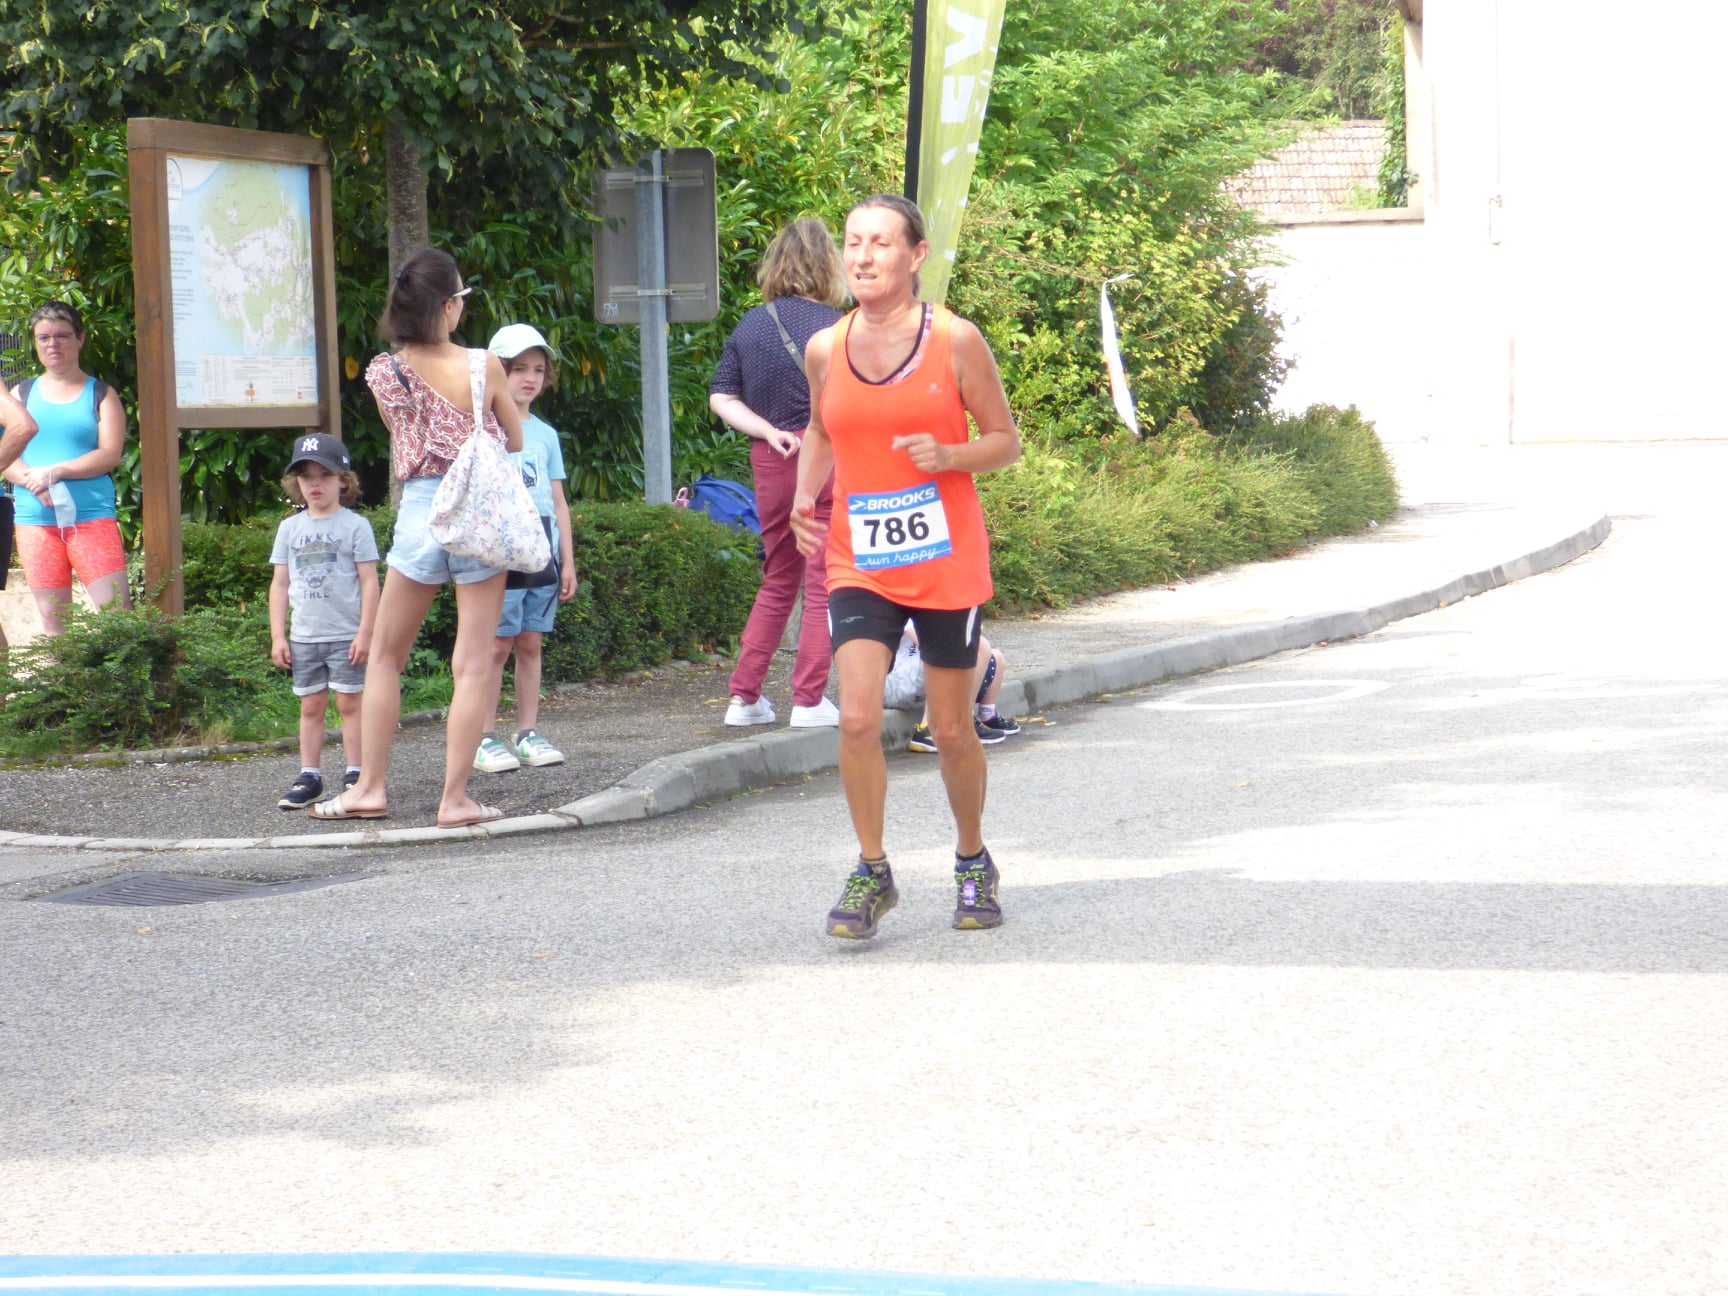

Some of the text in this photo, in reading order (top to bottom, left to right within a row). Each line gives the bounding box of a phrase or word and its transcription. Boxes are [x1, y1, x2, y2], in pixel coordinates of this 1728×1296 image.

[867, 487, 936, 510] BROOKS
[863, 511, 930, 548] 786
[866, 547, 936, 566] run happy
